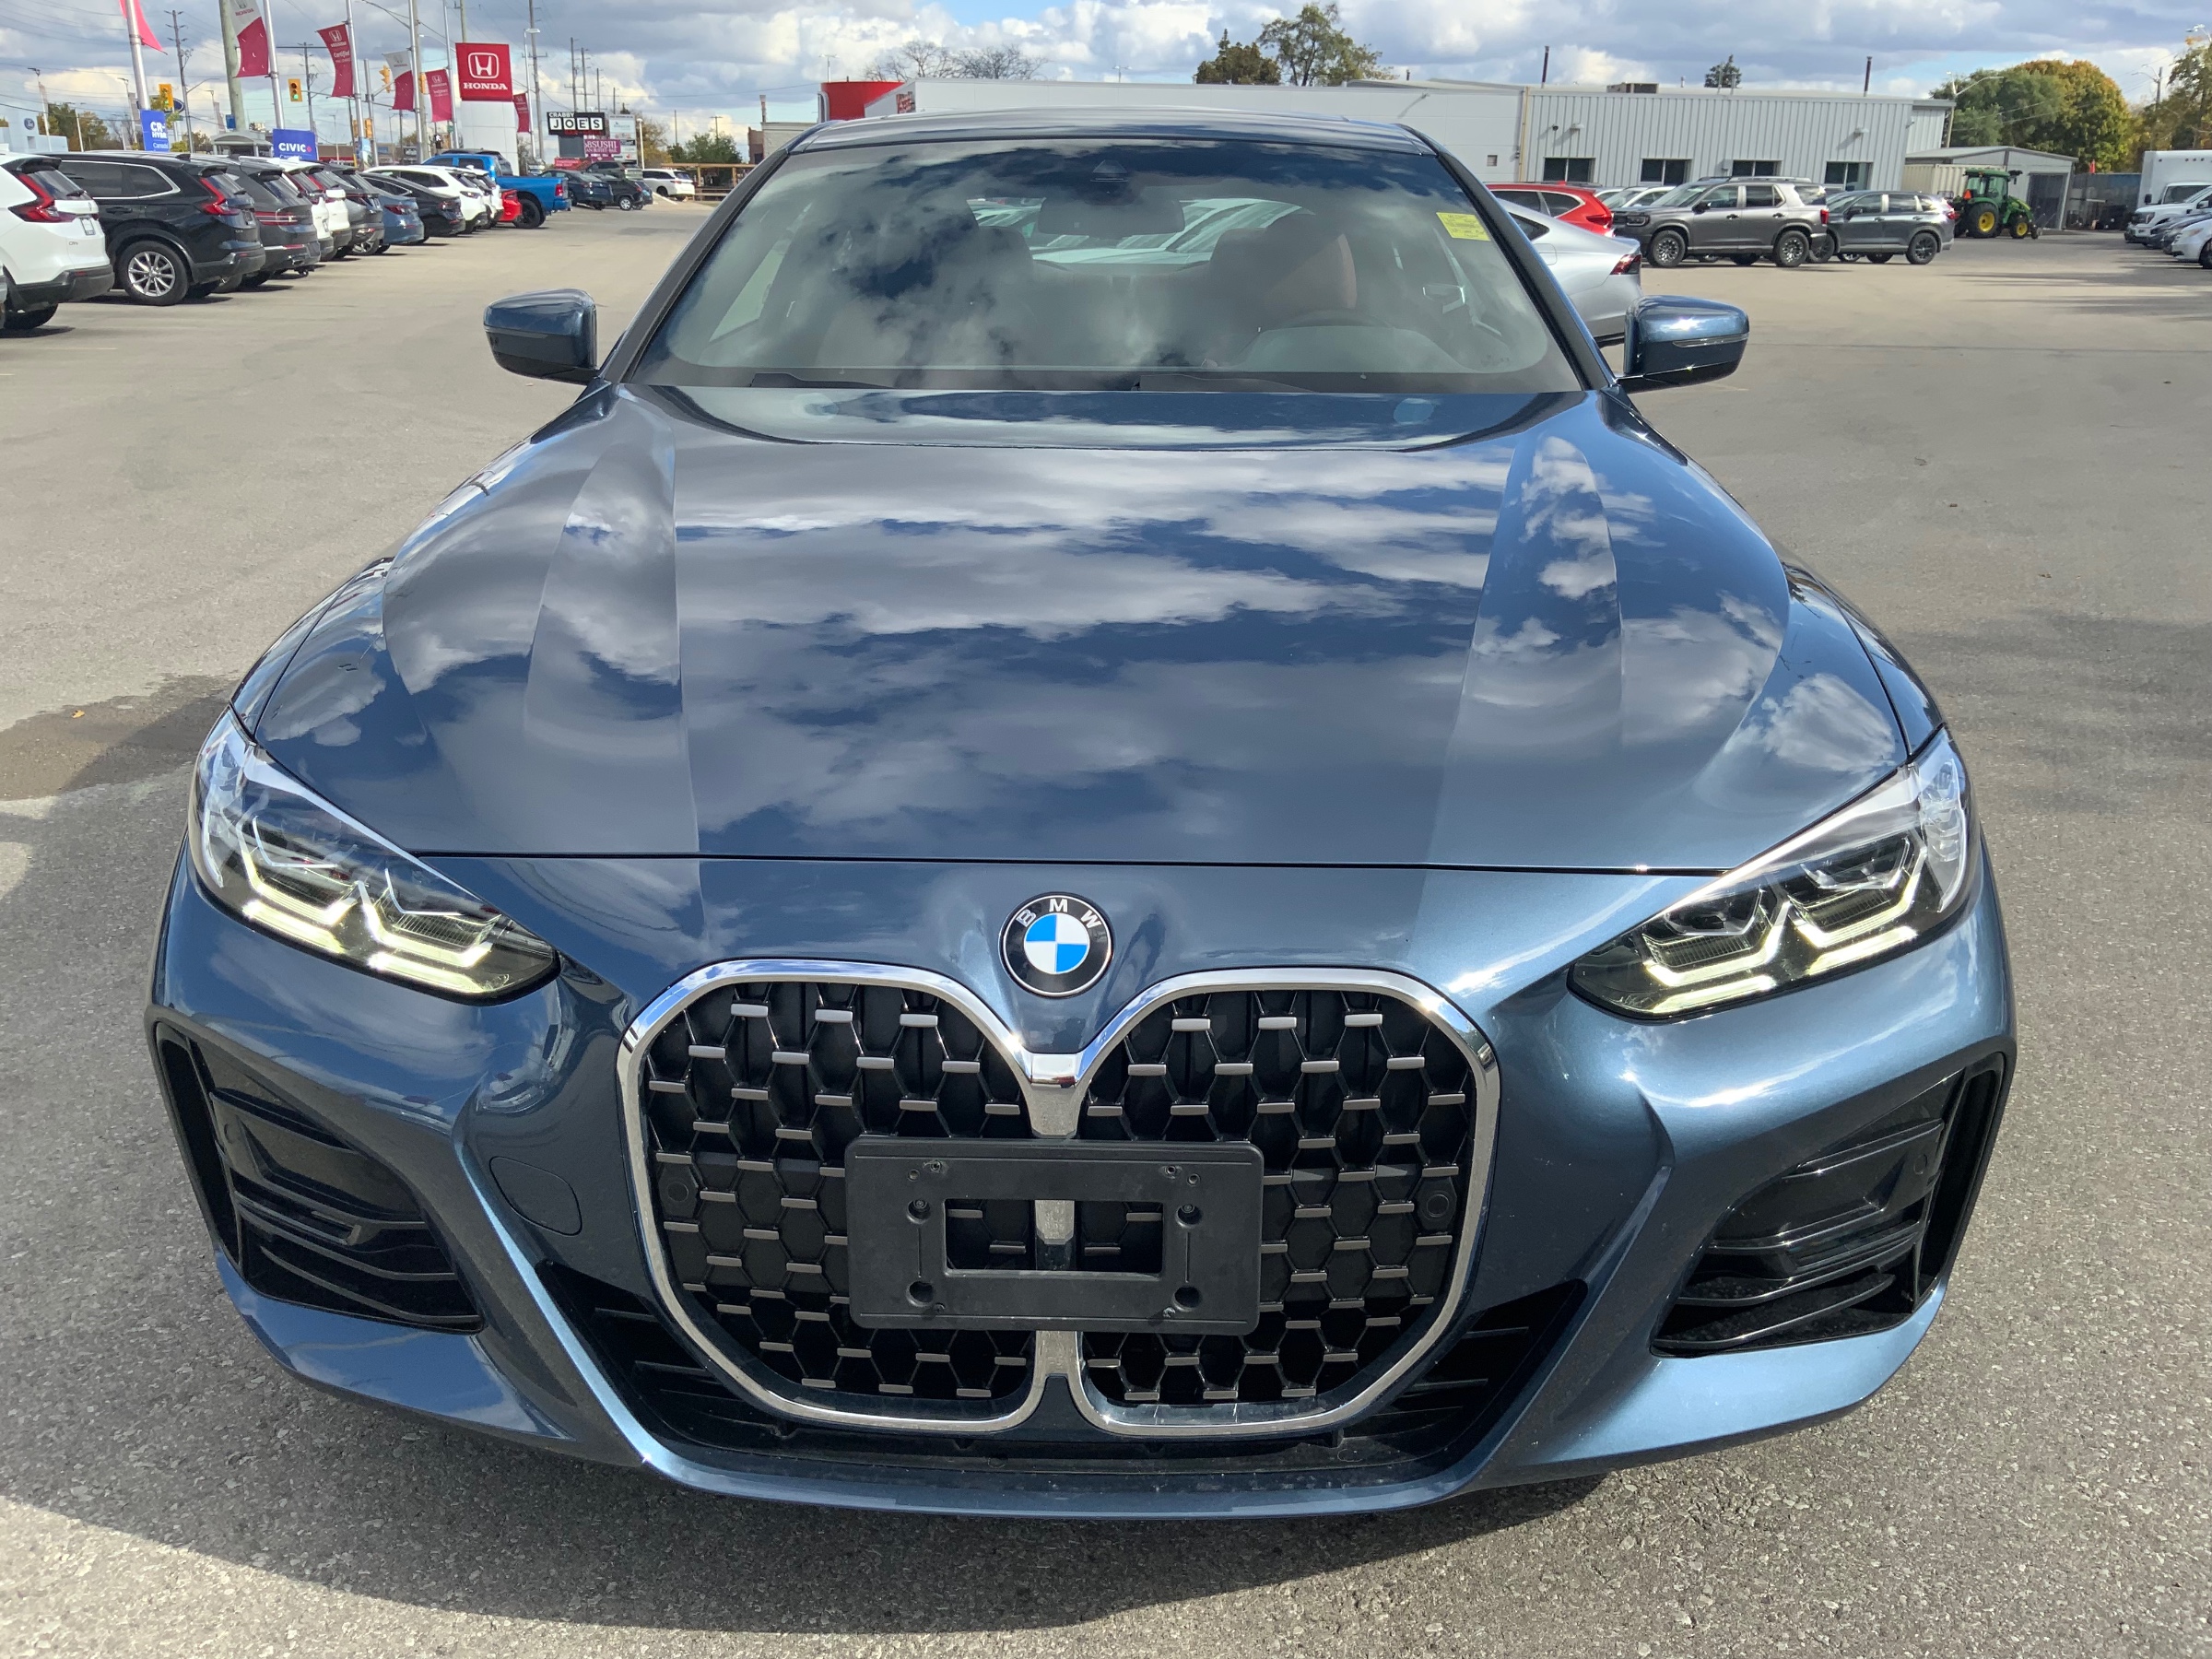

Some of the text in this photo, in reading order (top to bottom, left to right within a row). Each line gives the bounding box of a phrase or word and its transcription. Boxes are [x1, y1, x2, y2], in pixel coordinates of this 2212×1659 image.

[463, 82, 508, 90] HONDA
[278, 142, 307, 153] CIVIC
[1016, 898, 1102, 929] BMW
